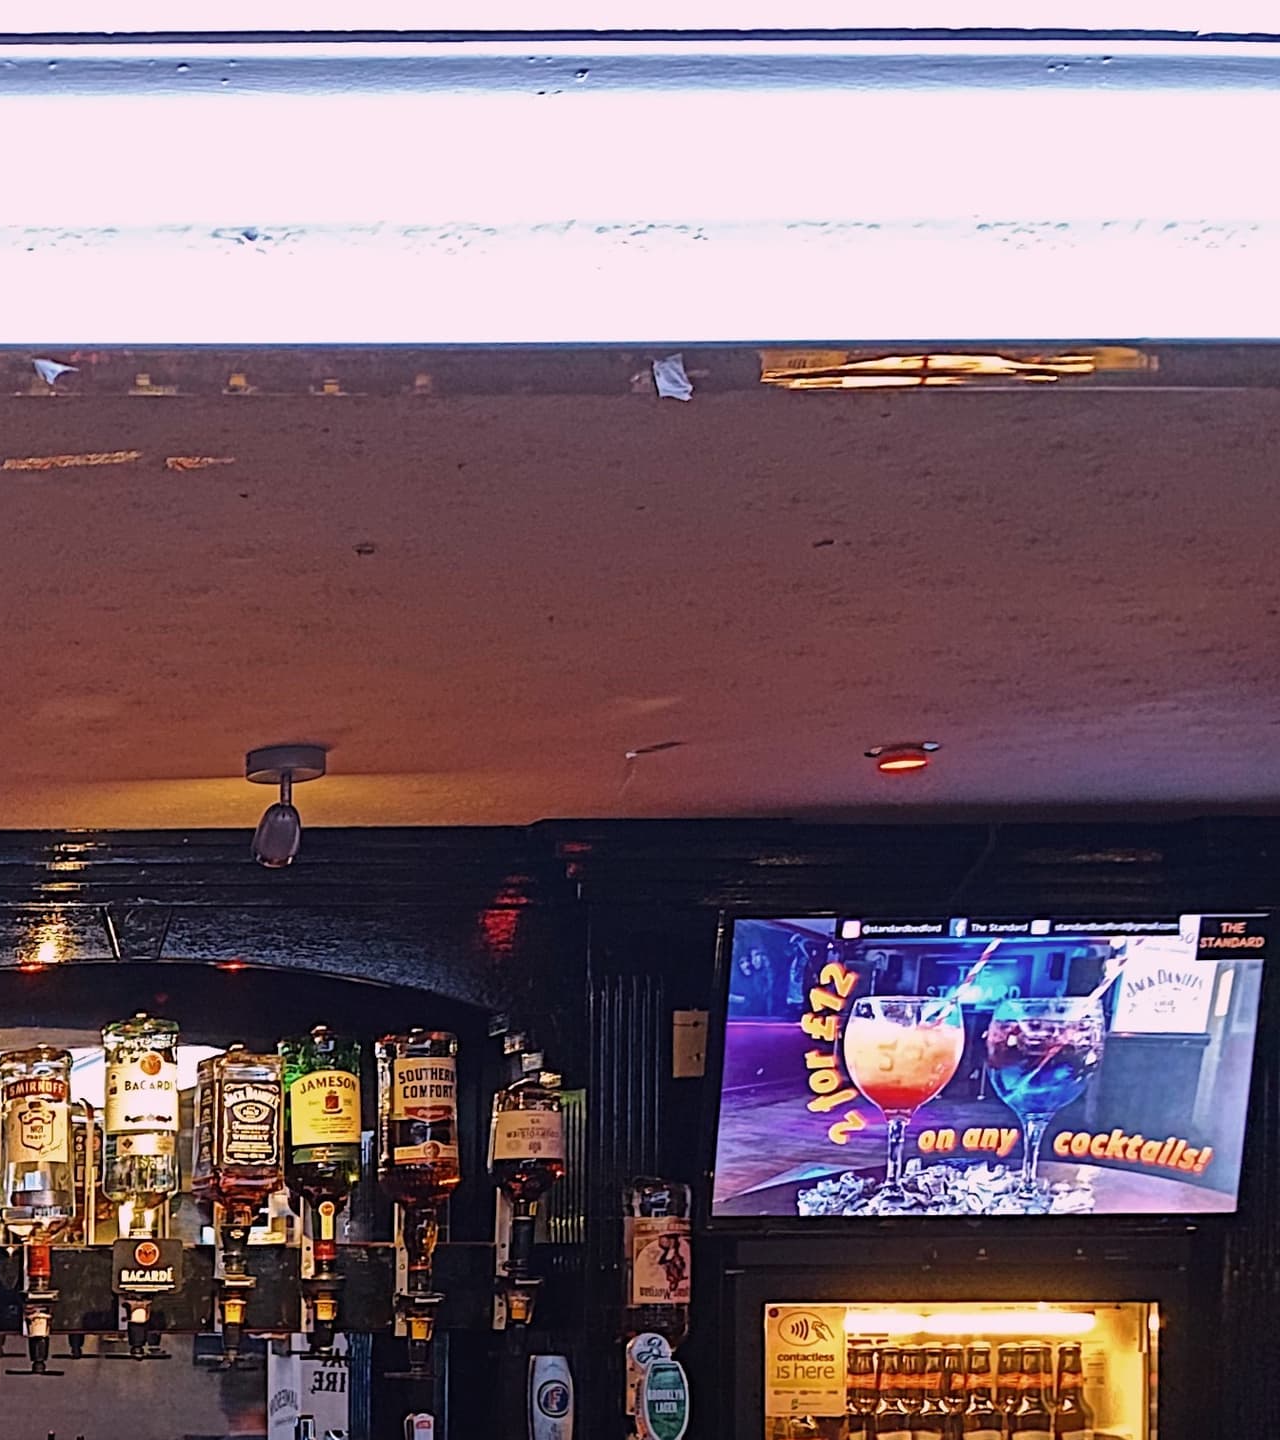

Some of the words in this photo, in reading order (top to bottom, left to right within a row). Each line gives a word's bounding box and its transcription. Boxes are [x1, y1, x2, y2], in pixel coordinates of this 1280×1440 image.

[971, 923, 988, 932] The
[990, 923, 1029, 933] Standard
[1220, 922, 1247, 935] THE
[1199, 936, 1266, 950] STANDARD
[800, 962, 860, 1042] £12
[398, 1066, 456, 1085] SOUTHERN
[804, 1048, 858, 1115] for
[9, 1080, 65, 1098] SMIRNOFF
[299, 1075, 357, 1095] JAMESON
[402, 1084, 454, 1099] COMFORT
[827, 1110, 867, 1146] 2
[918, 1128, 954, 1152] on
[962, 1126, 1020, 1158] any
[1053, 1129, 1216, 1174] cocktails!
[777, 1352, 835, 1362] contactless
[776, 1365, 790, 1379] is
[793, 1363, 835, 1379] here
[647, 1388, 685, 1401] BROOKLYN
[655, 1402, 678, 1415] LAGER
